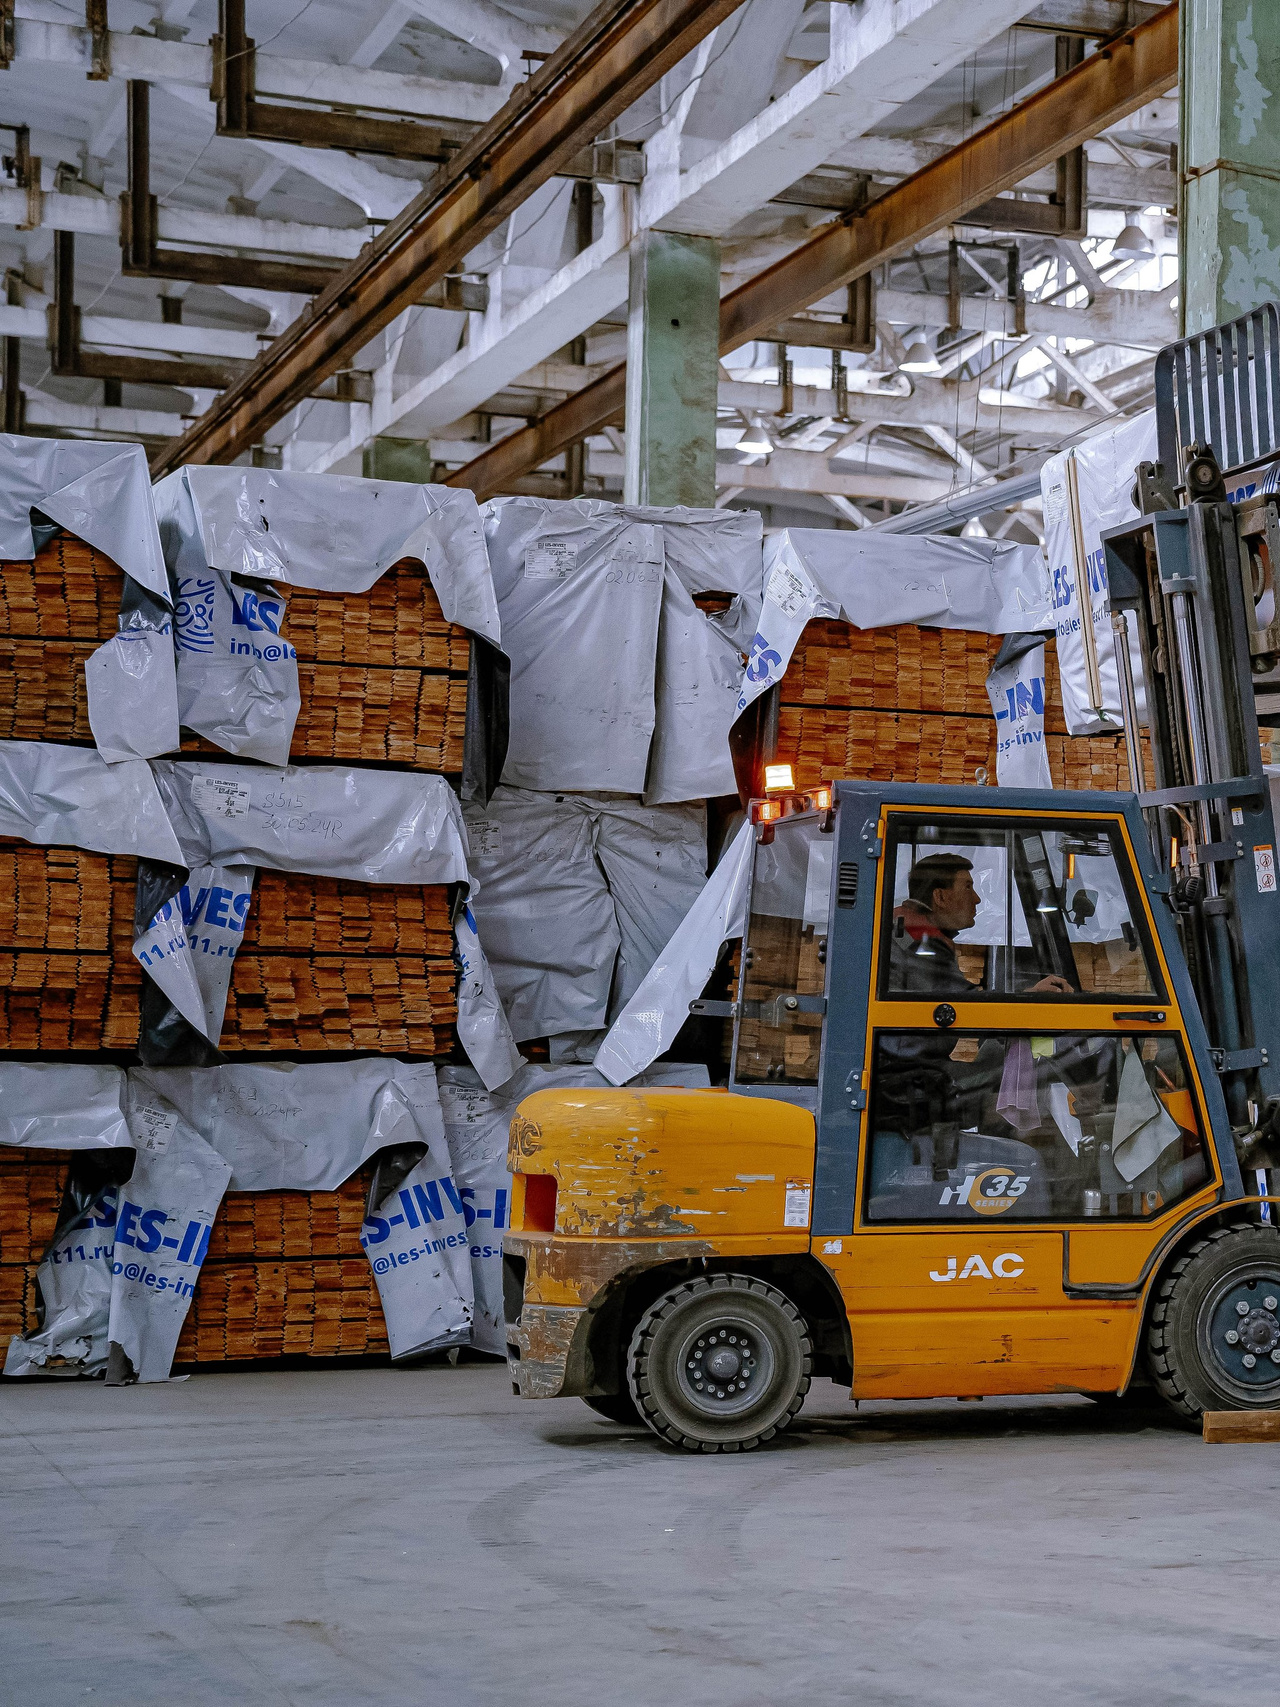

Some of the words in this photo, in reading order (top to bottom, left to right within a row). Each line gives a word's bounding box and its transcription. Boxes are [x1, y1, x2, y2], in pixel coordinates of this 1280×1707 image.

[986, 1175, 1031, 1197] 35
[975, 1199, 1016, 1208] SERIES
[929, 1252, 1025, 1282] JAC
